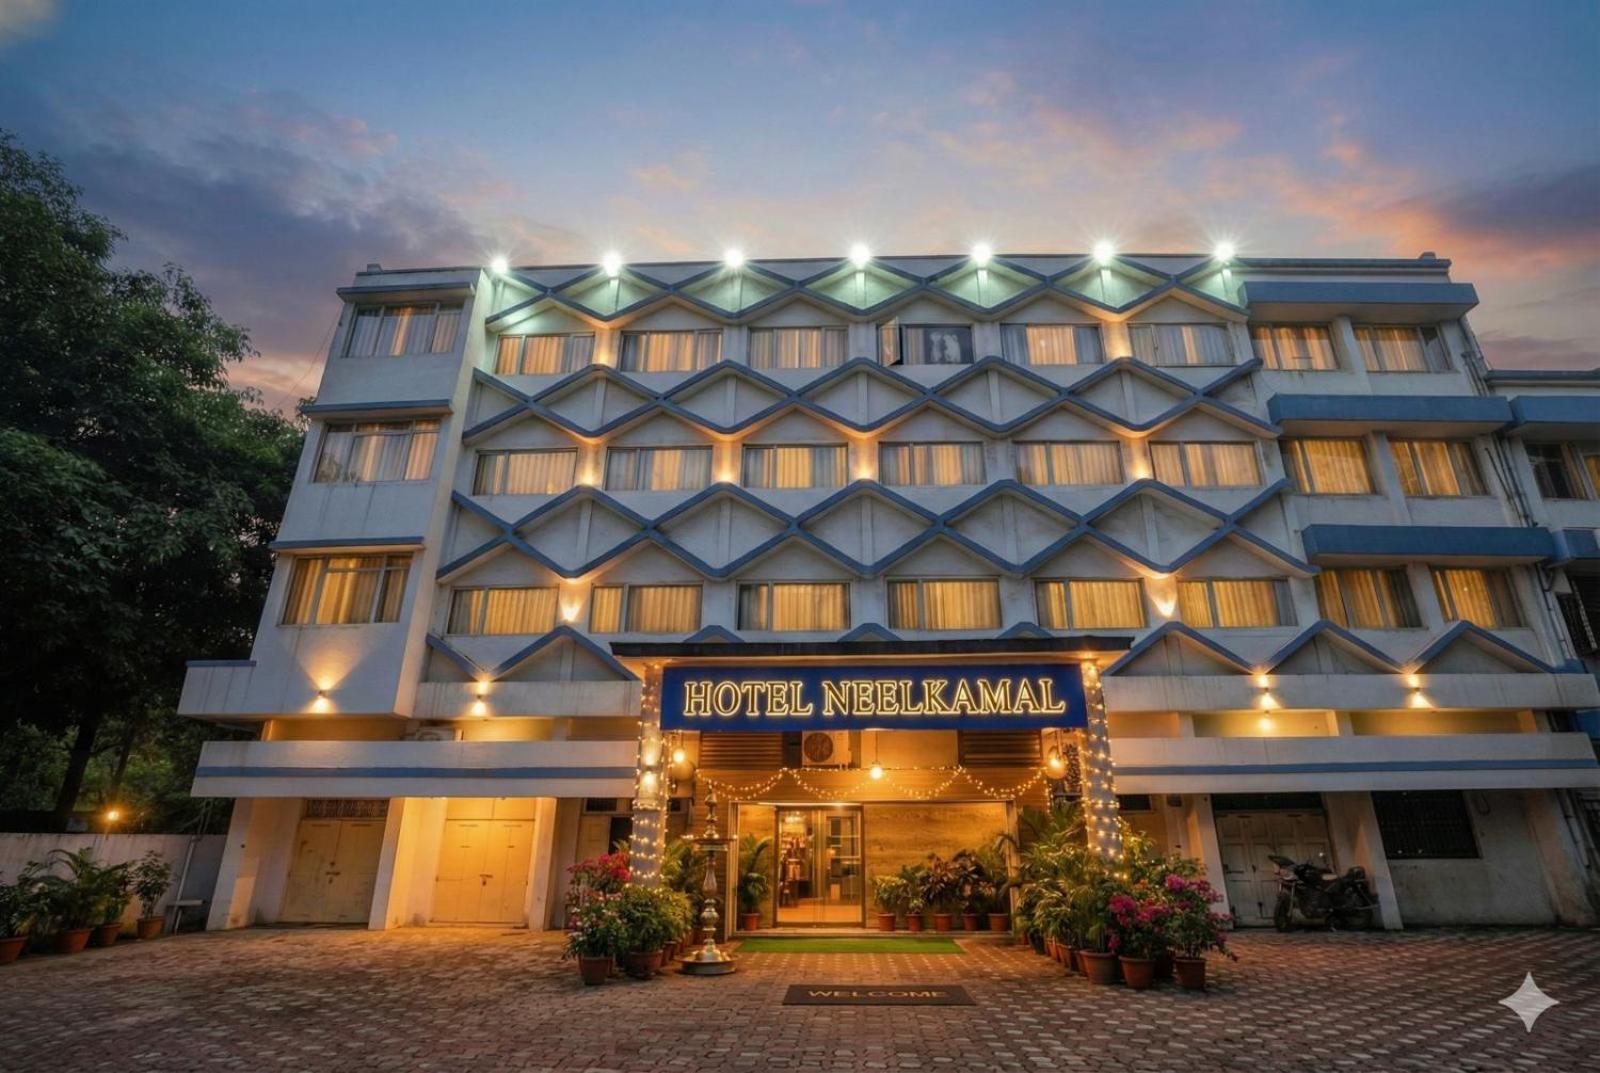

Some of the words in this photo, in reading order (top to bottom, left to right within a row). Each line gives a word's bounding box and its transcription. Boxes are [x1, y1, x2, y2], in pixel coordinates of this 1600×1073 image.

[683, 680, 812, 717] HOTEL
[823, 678, 1066, 716] NEELKAMAL
[808, 990, 946, 998] WELCOME
